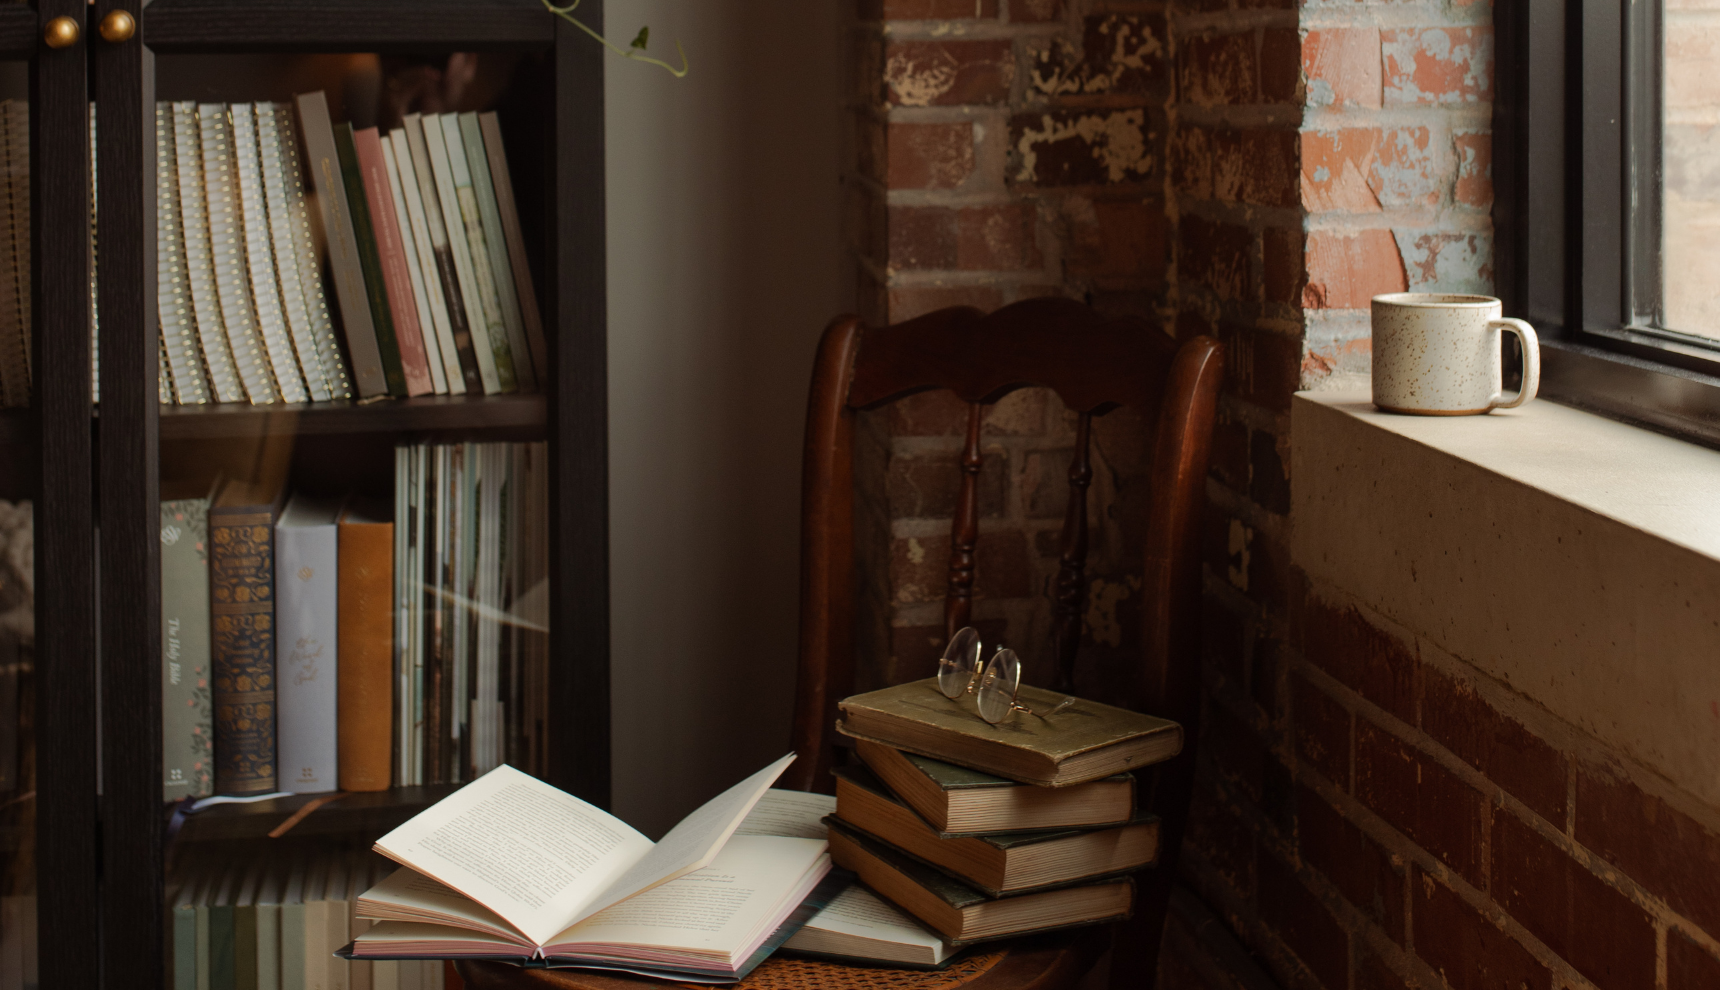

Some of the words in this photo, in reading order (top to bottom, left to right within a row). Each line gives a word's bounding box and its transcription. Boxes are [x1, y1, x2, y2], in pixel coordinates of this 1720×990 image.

[168, 618, 180, 636] The
[166, 638, 181, 661] Holy
[169, 662, 181, 686] Bible
